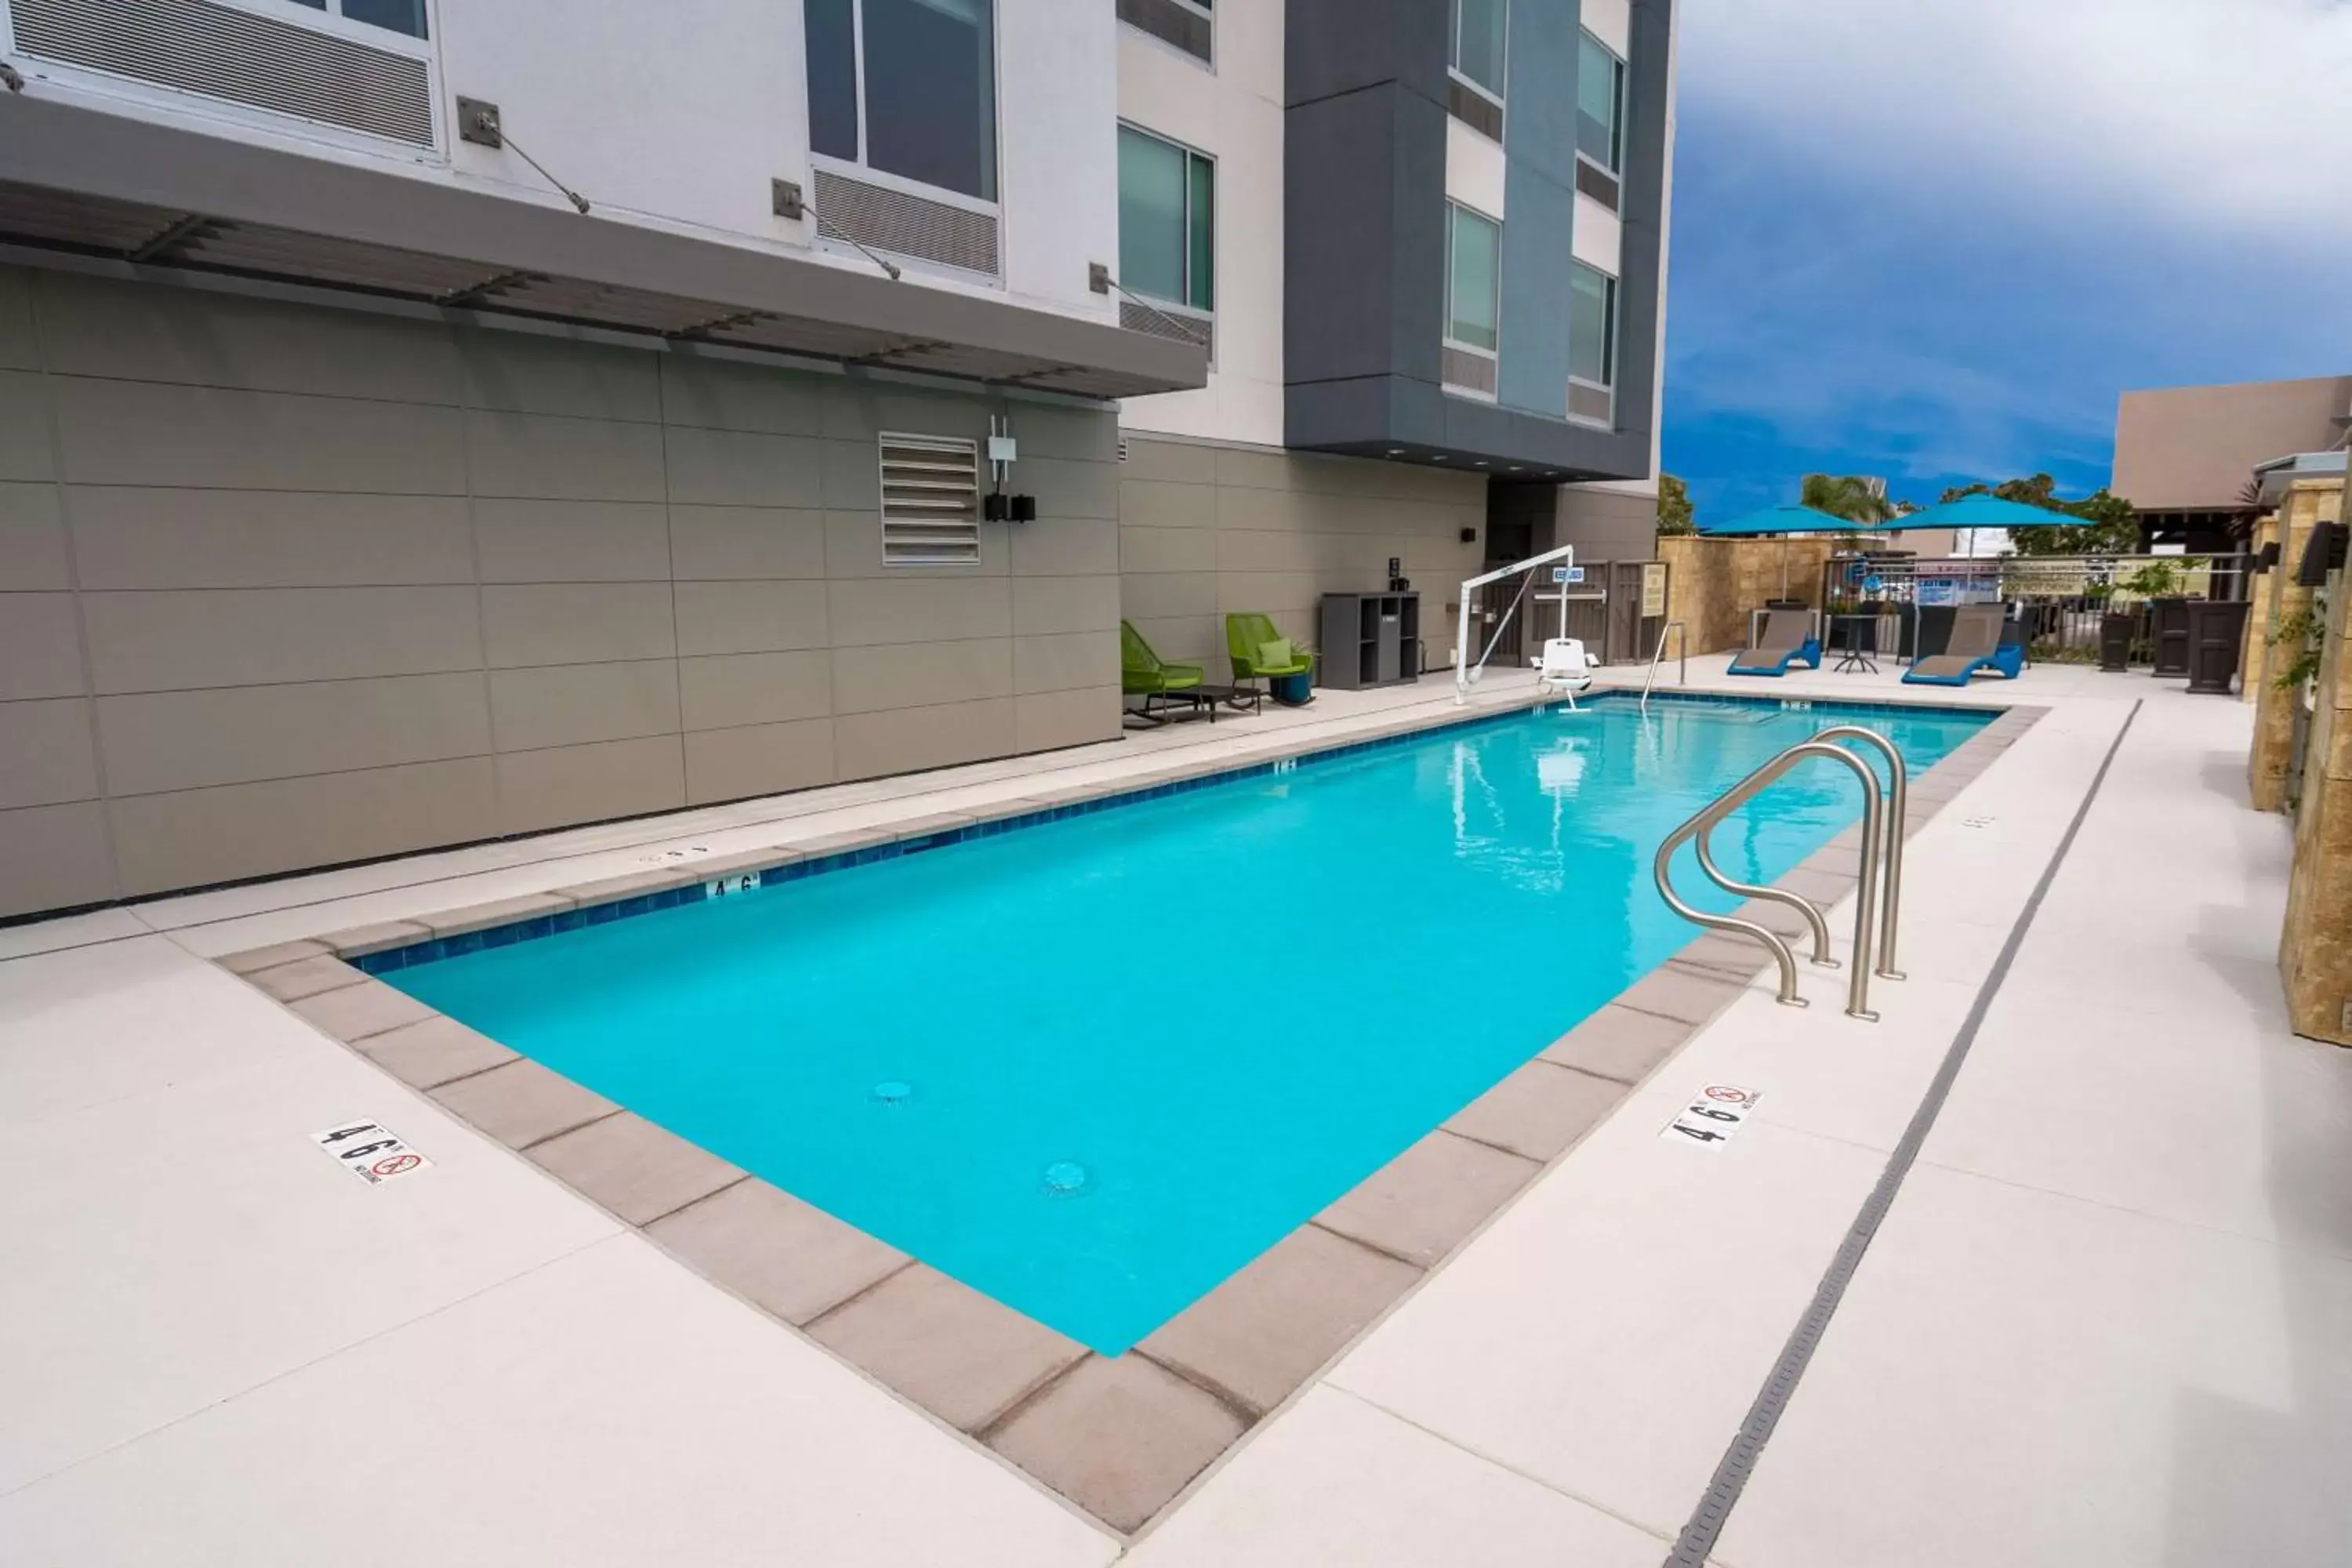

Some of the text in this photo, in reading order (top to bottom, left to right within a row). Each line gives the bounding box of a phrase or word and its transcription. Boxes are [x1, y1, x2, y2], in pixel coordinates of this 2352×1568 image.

[321, 1123, 397, 1159] 4 6
[1672, 1106, 1740, 1142] 4 6
